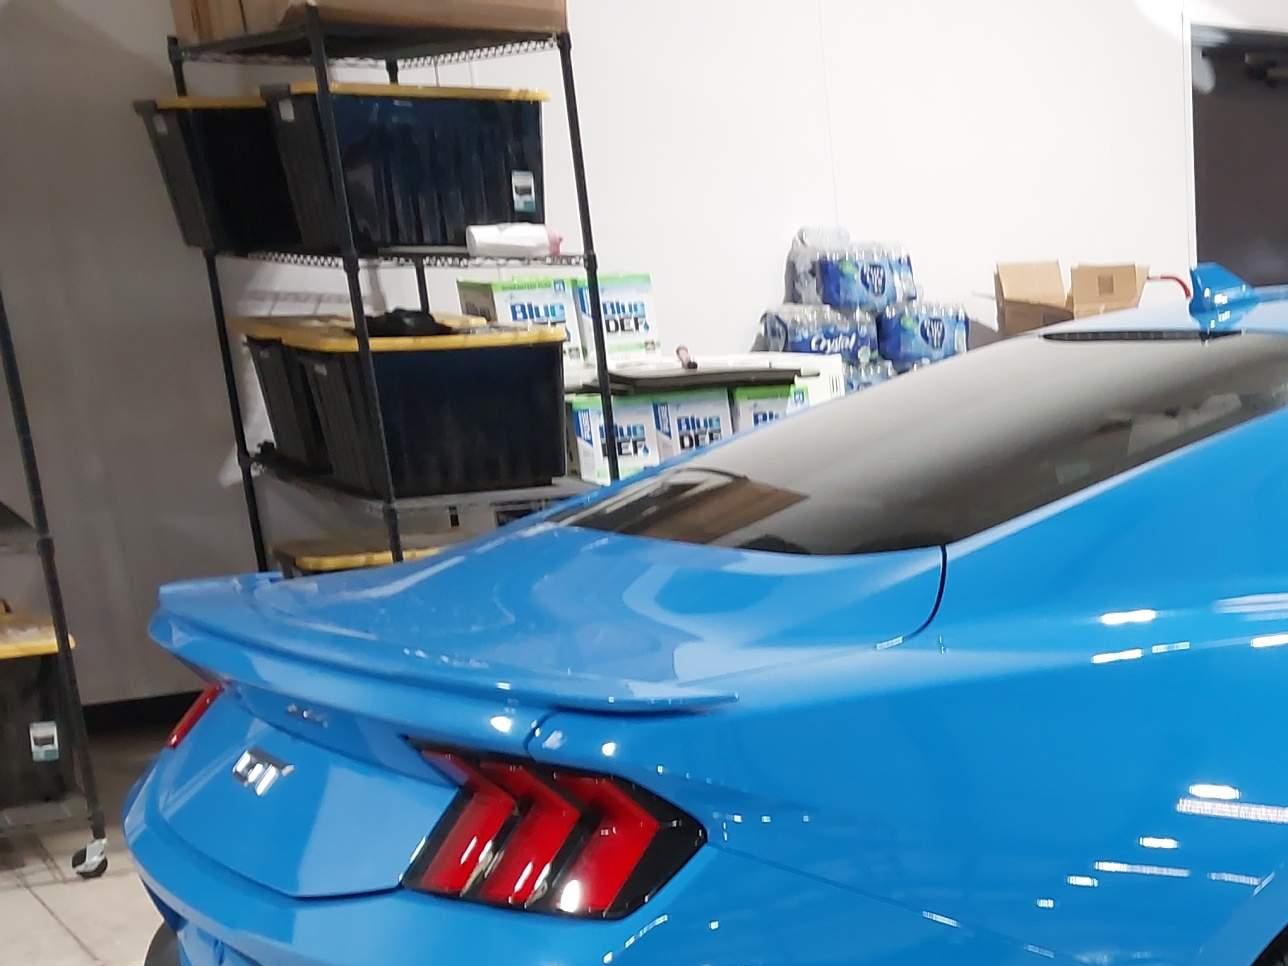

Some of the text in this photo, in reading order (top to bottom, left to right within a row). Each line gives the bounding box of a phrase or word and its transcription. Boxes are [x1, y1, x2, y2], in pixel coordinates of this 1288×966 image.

[510, 303, 567, 325] Blue
[602, 301, 646, 318] Blue
[605, 316, 644, 333] DEF
[677, 414, 720, 431] Blue
